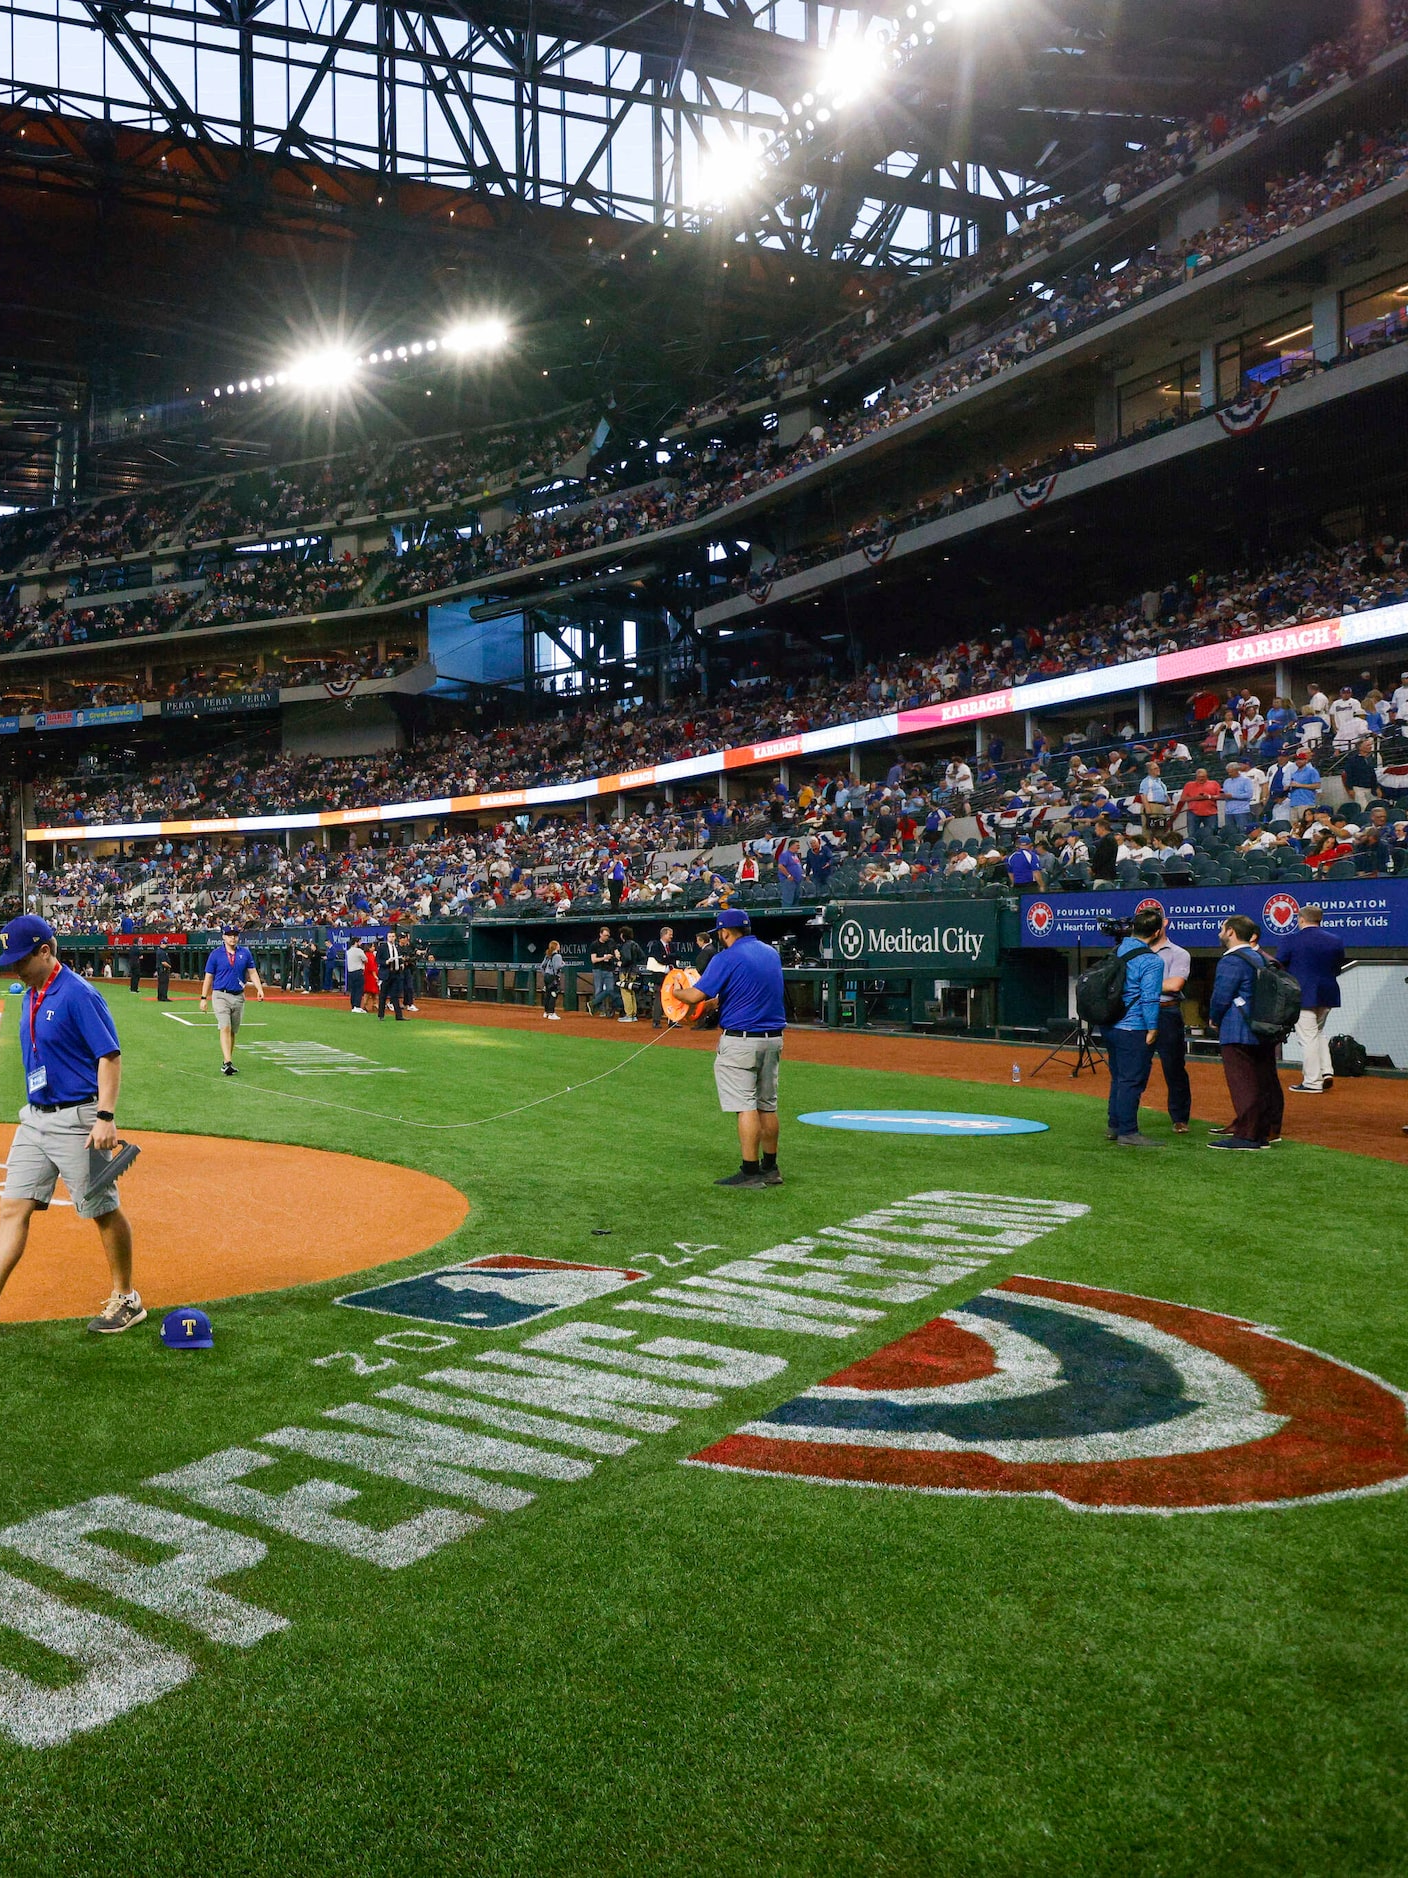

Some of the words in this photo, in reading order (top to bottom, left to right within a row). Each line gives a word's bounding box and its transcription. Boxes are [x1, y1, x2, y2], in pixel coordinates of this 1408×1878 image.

[1226, 625, 1331, 662] KARBACH
[203, 697, 233, 708] PERRY
[241, 693, 272, 704] PERRY
[166, 701, 196, 711] PERRY
[941, 694, 1008, 722] KARBACH
[753, 740, 799, 760] KARBACH
[1056, 908, 1112, 917] FOUNDATION
[1169, 904, 1236, 914] FOUNDATION
[1056, 923, 1062, 932] A
[1063, 922, 1086, 932] Heart
[1086, 922, 1096, 931] for
[1168, 921, 1176, 930] A
[1177, 920, 1201, 930] Heart
[1202, 919, 1216, 929] for
[1345, 916, 1363, 927] for
[1364, 916, 1389, 927] Kids
[0, 933, 10, 950] T
[867, 926, 940, 953] Medical
[942, 926, 985, 961] City
[46, 1009, 55, 1021] T
[629, 1241, 734, 1268] 24
[613, 1189, 1093, 1338] WEEKEND
[181, 1318, 197, 1336] T
[311, 1329, 459, 1376] 20
